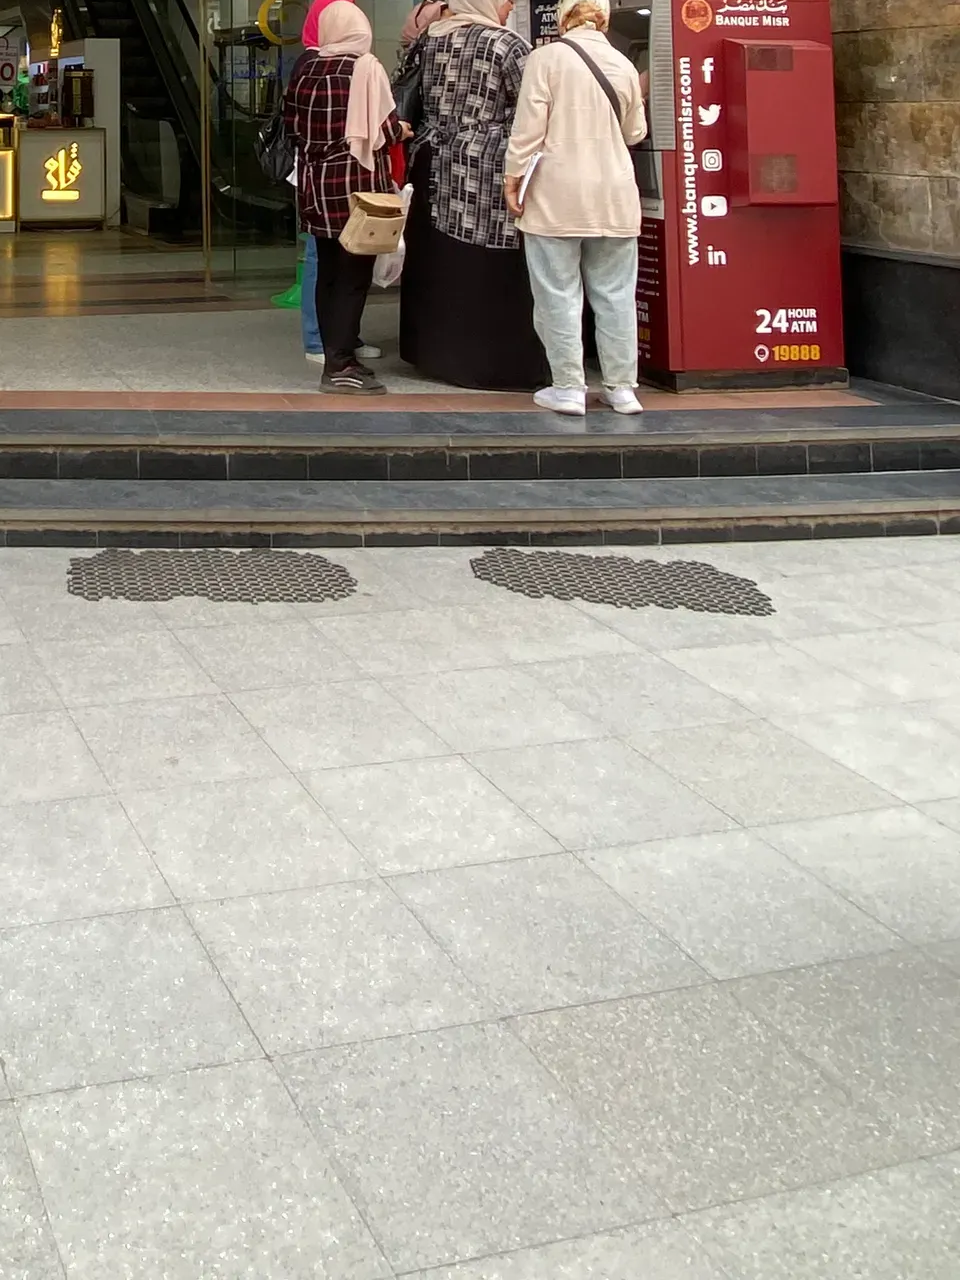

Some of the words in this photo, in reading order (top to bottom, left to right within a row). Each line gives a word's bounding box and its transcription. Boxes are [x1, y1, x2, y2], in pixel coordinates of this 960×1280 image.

[715, 14, 759, 27] BANQUE
[762, 15, 790, 27] MISR
[678, 57, 700, 266] www.banquemisr.com
[755, 308, 789, 334] 24
[788, 308, 817, 319] HOUR
[790, 320, 817, 333] ATM
[771, 344, 820, 361] 19888
